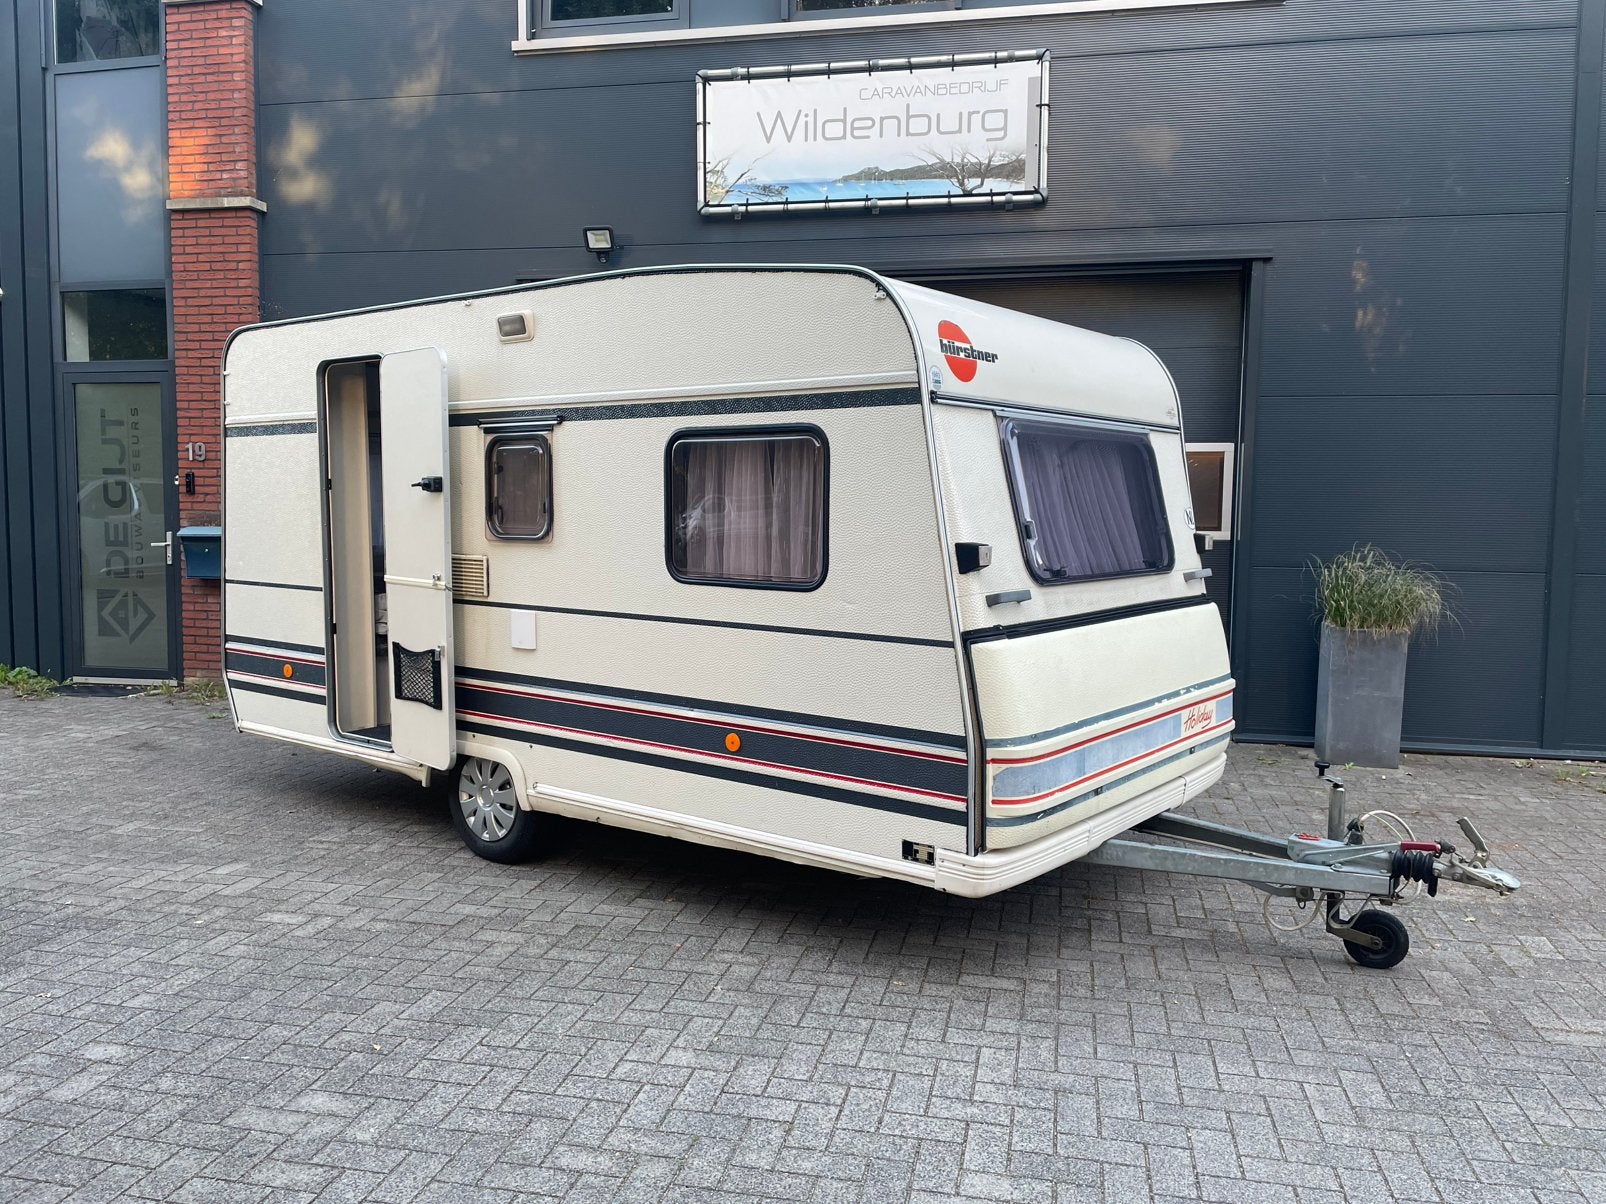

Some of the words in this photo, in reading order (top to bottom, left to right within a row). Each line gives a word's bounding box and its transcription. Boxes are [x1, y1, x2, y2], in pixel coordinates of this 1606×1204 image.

[858, 79, 1009, 101] CARAVANBEDRIJF
[756, 103, 1009, 144] Wildenburg
[939, 339, 999, 363] bürstner
[185, 442, 206, 461] 19
[130, 407, 145, 579] BOUWAVISEURS
[1184, 705, 1214, 732] Holiday
